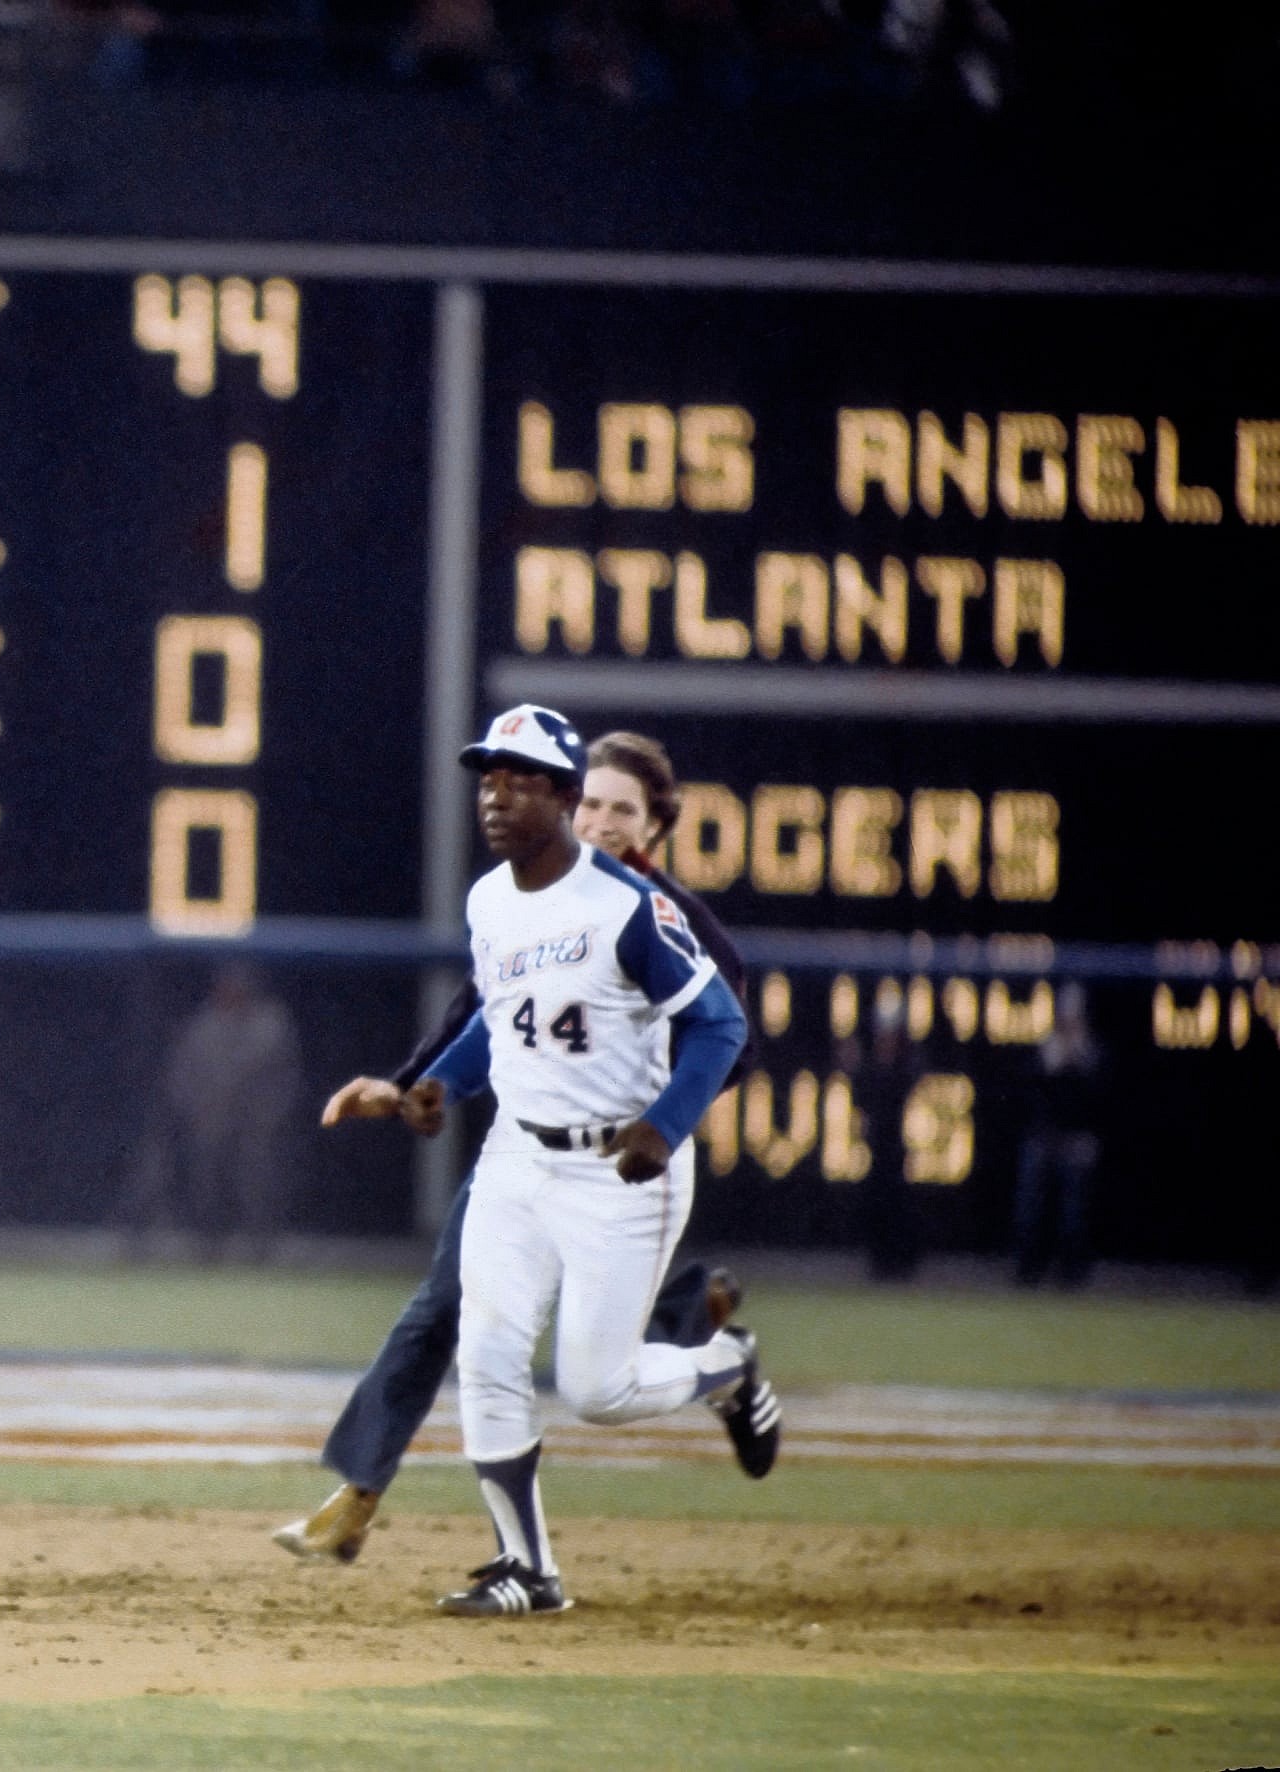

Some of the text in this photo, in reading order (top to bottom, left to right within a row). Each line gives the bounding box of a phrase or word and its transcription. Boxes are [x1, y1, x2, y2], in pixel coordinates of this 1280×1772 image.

[132, 272, 301, 400] 44
[224, 440, 268, 592] 1
[516, 400, 1280, 527] LOS ANGELE
[514, 543, 1067, 669] ATLANTA
[153, 613, 263, 766] 0
[148, 786, 258, 939] 0
[652, 781, 1062, 903] DGERS
[512, 996, 589, 1054] 44
